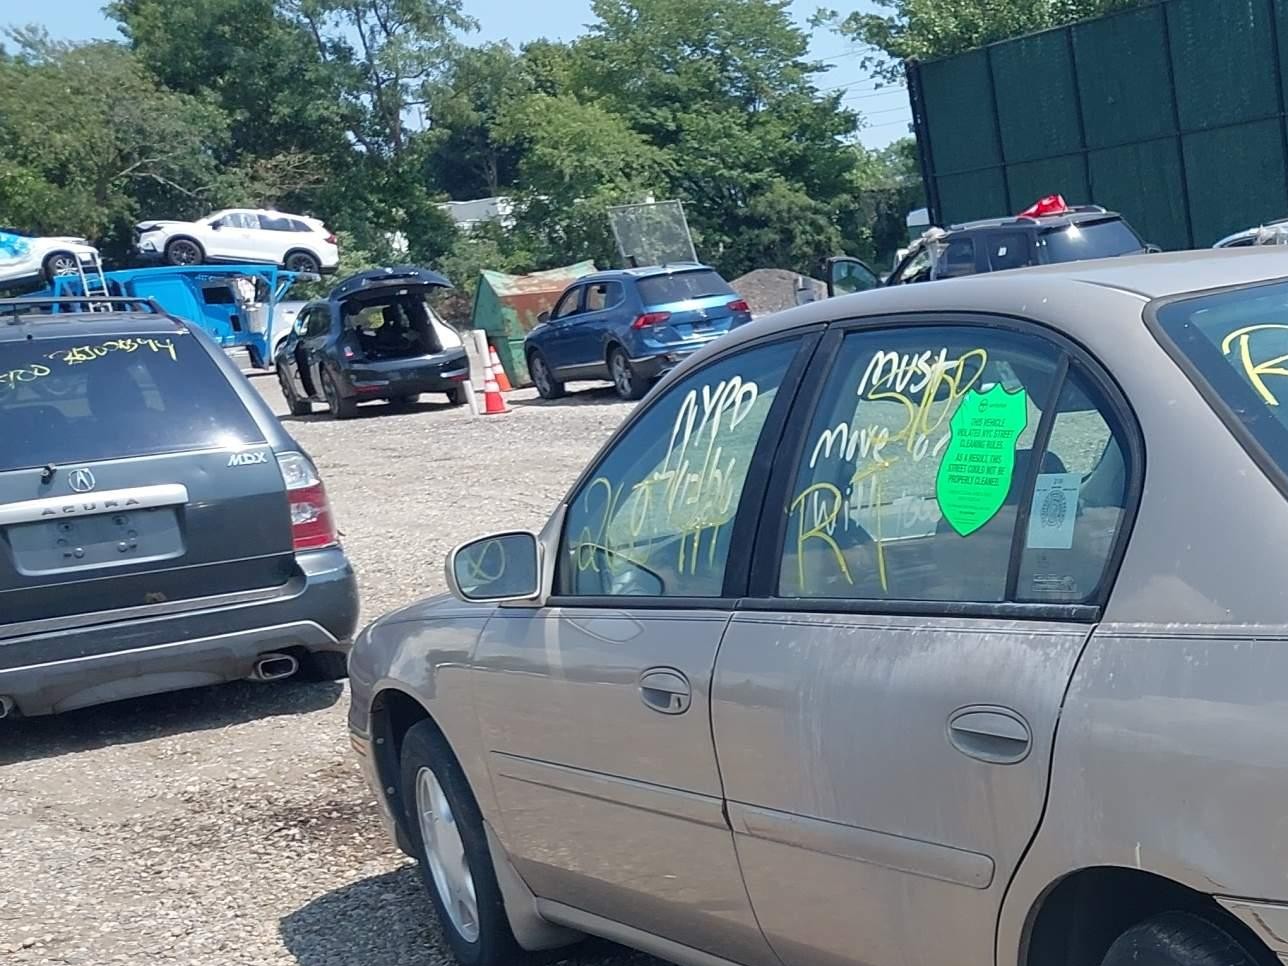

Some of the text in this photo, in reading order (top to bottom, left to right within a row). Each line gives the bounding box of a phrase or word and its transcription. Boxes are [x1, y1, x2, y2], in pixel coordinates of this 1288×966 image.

[663, 375, 759, 478] NYPD
[960, 440, 985, 449] CLEANING
[226, 452, 268, 467] MDX
[968, 465, 985, 474] COULD
[41, 499, 140, 516] ACURA
